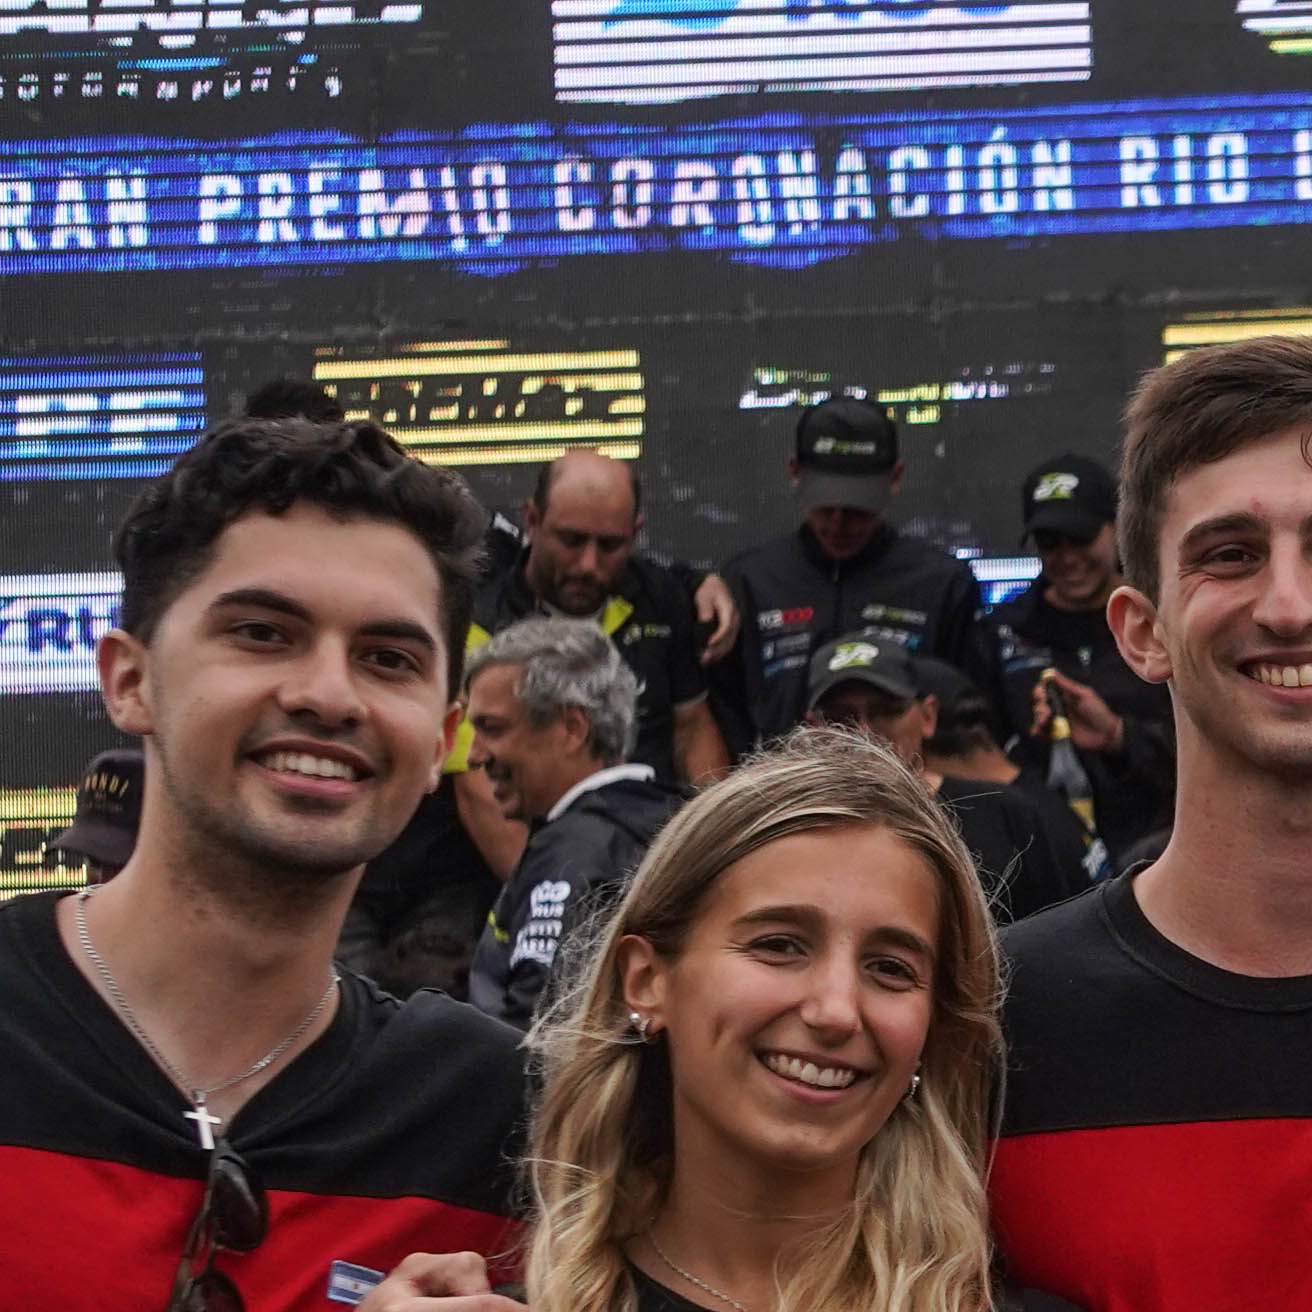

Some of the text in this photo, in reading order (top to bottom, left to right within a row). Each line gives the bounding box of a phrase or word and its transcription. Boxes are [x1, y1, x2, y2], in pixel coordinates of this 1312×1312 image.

[0, 166, 148, 251] RAN
[199, 158, 511, 251] PREMIO
[553, 128, 1074, 240] CORONACIÓN
[1120, 131, 1249, 208] RIO
